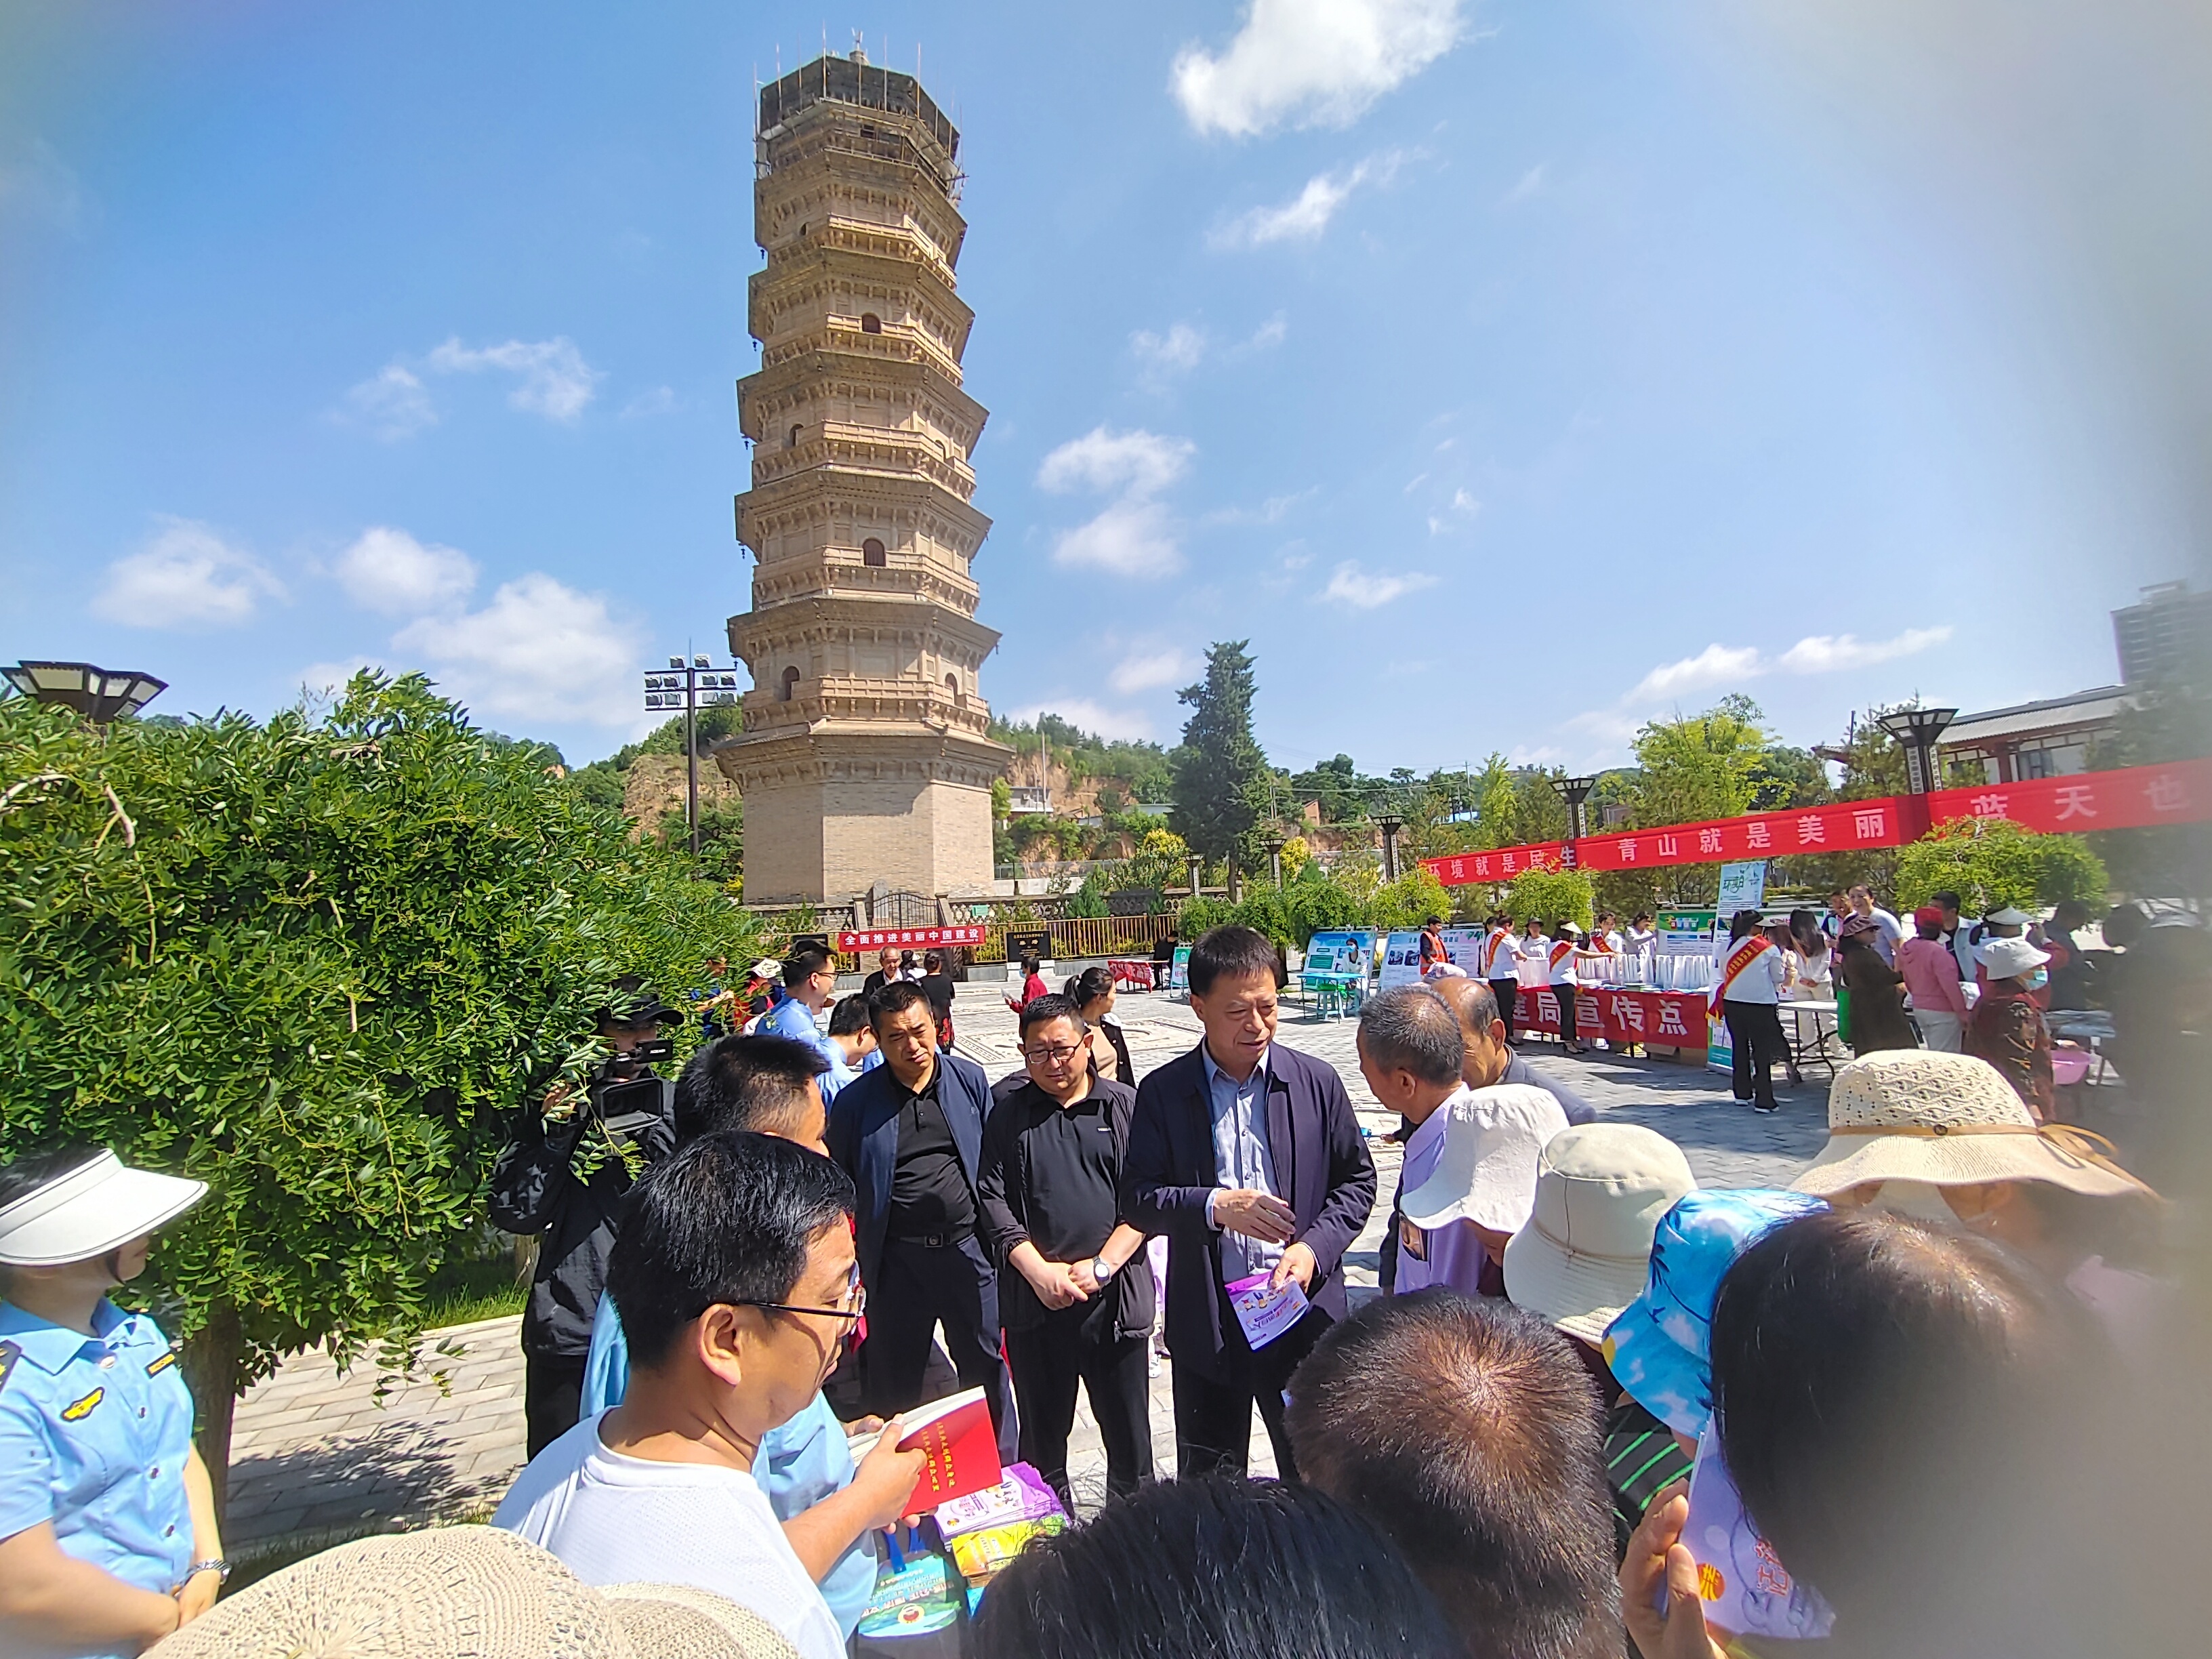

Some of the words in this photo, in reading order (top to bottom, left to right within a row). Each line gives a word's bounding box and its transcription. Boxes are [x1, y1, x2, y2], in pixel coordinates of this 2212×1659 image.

[1618, 808, 1885, 861] 青山就是美丽
[844, 928, 979, 945] 全面推进美丽中国建设
